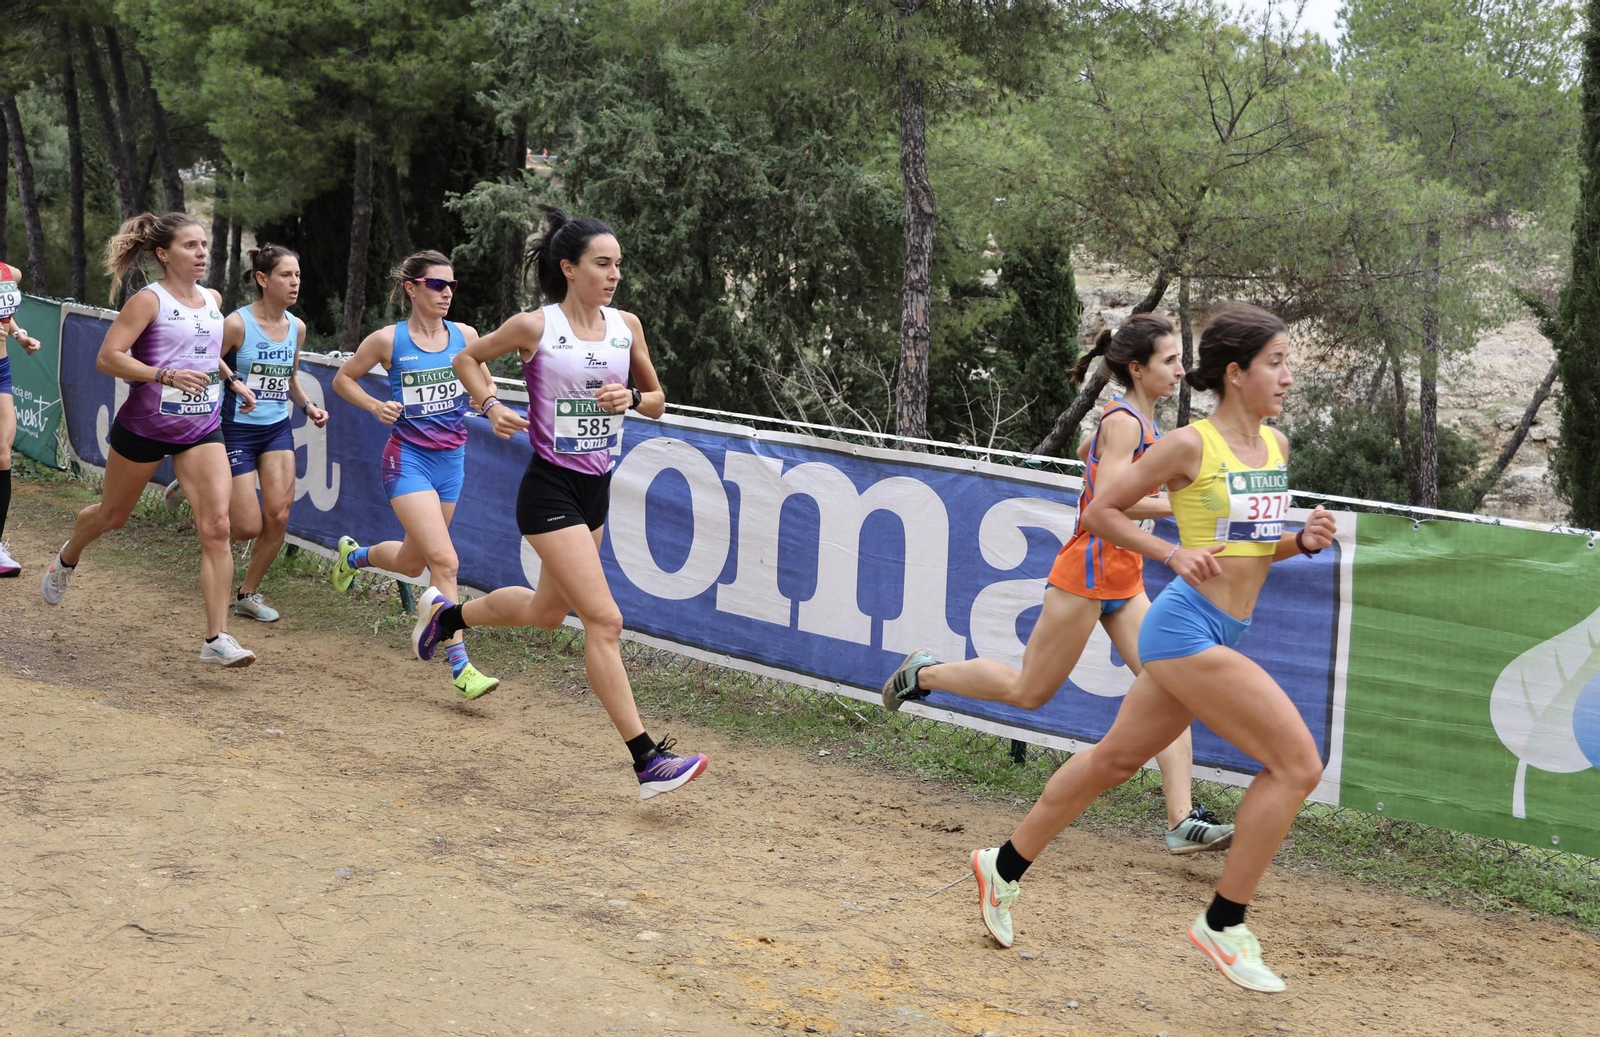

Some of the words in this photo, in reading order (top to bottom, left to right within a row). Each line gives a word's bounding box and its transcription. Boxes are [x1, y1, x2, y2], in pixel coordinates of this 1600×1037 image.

[257, 346, 293, 362] nerja
[415, 382, 457, 402] 1799
[177, 403, 212, 414] Joma
[421, 399, 455, 415] Joma
[575, 400, 611, 413] ITÁLI
[577, 418, 611, 437] 585
[574, 437, 608, 451] Joma
[1250, 523, 1284, 539] Jom
